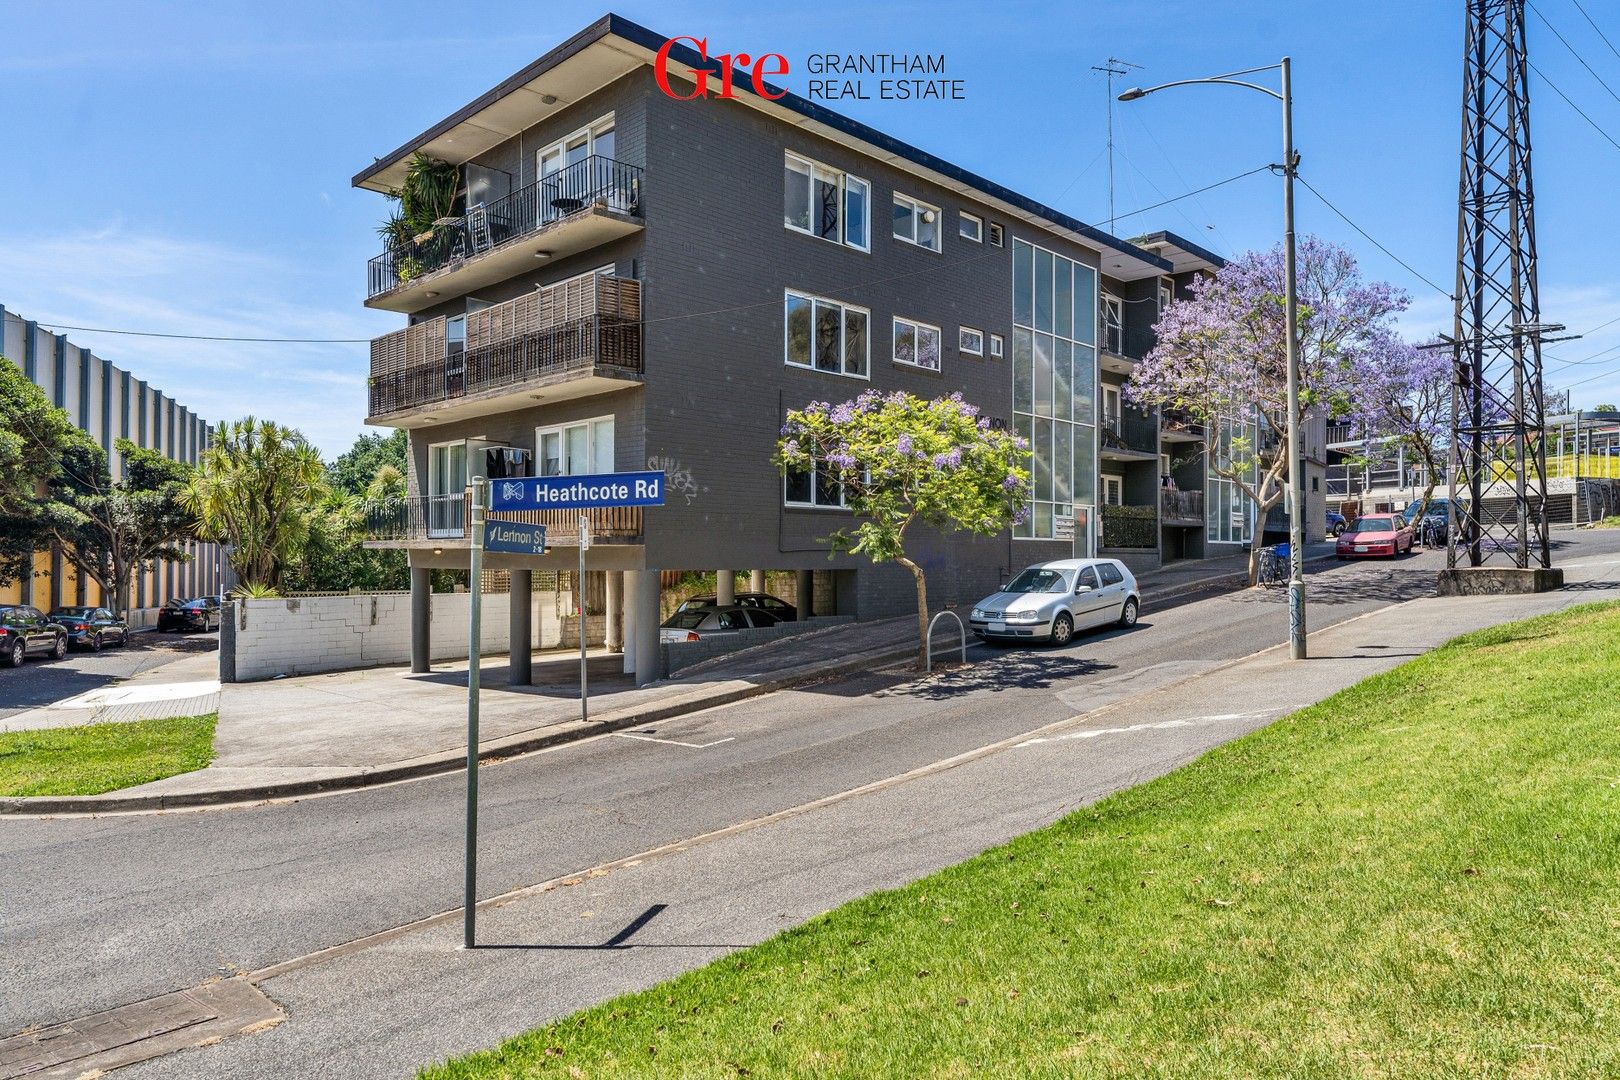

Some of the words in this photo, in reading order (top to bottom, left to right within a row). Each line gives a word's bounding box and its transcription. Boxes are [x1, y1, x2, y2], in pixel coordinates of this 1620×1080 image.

[535, 482, 629, 503] Heathcote
[635, 479, 659, 499] Rd
[533, 530, 543, 545] St
